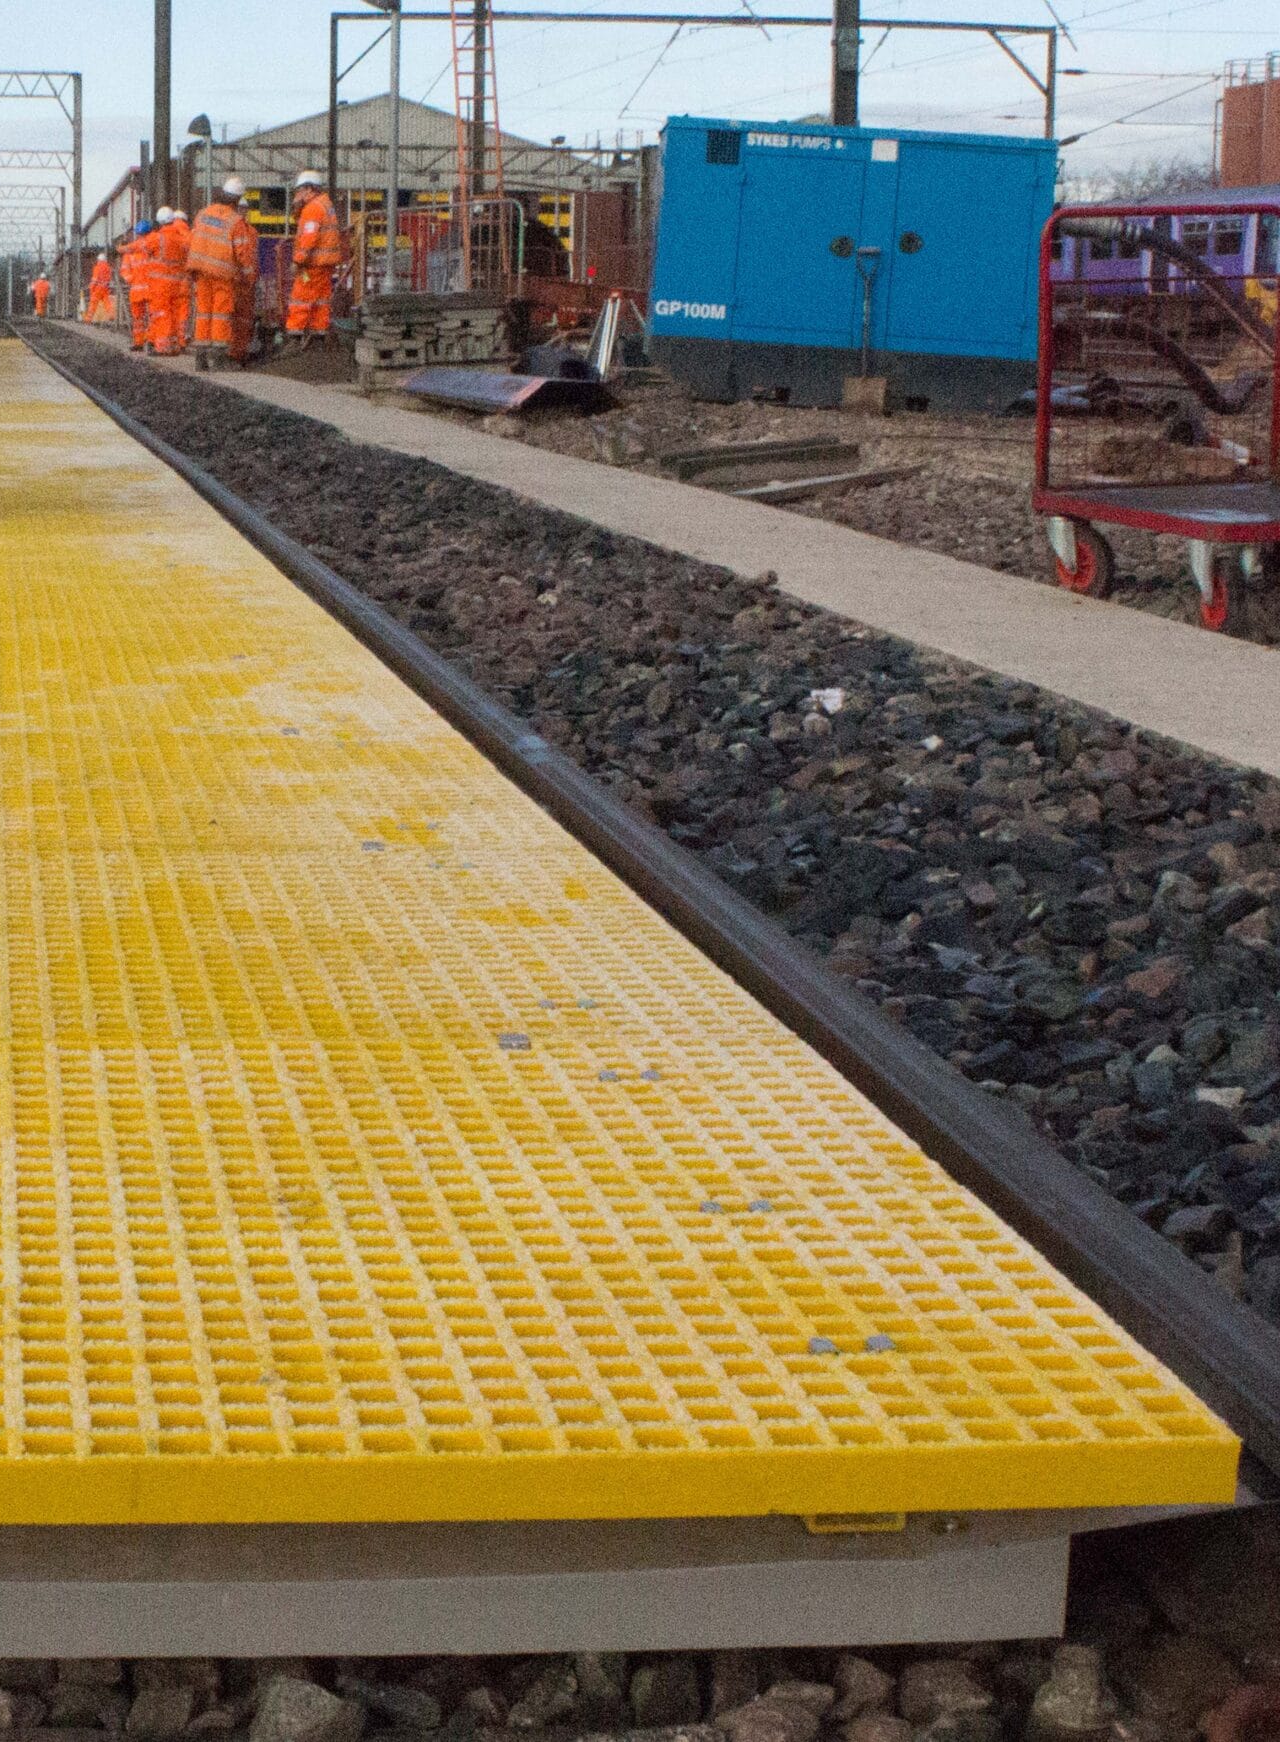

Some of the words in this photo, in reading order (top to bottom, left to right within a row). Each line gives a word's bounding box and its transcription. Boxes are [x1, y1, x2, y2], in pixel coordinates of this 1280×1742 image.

[746, 132, 789, 148] SYKES
[791, 134, 832, 151] PUMPS
[655, 299, 727, 320] GP100M
